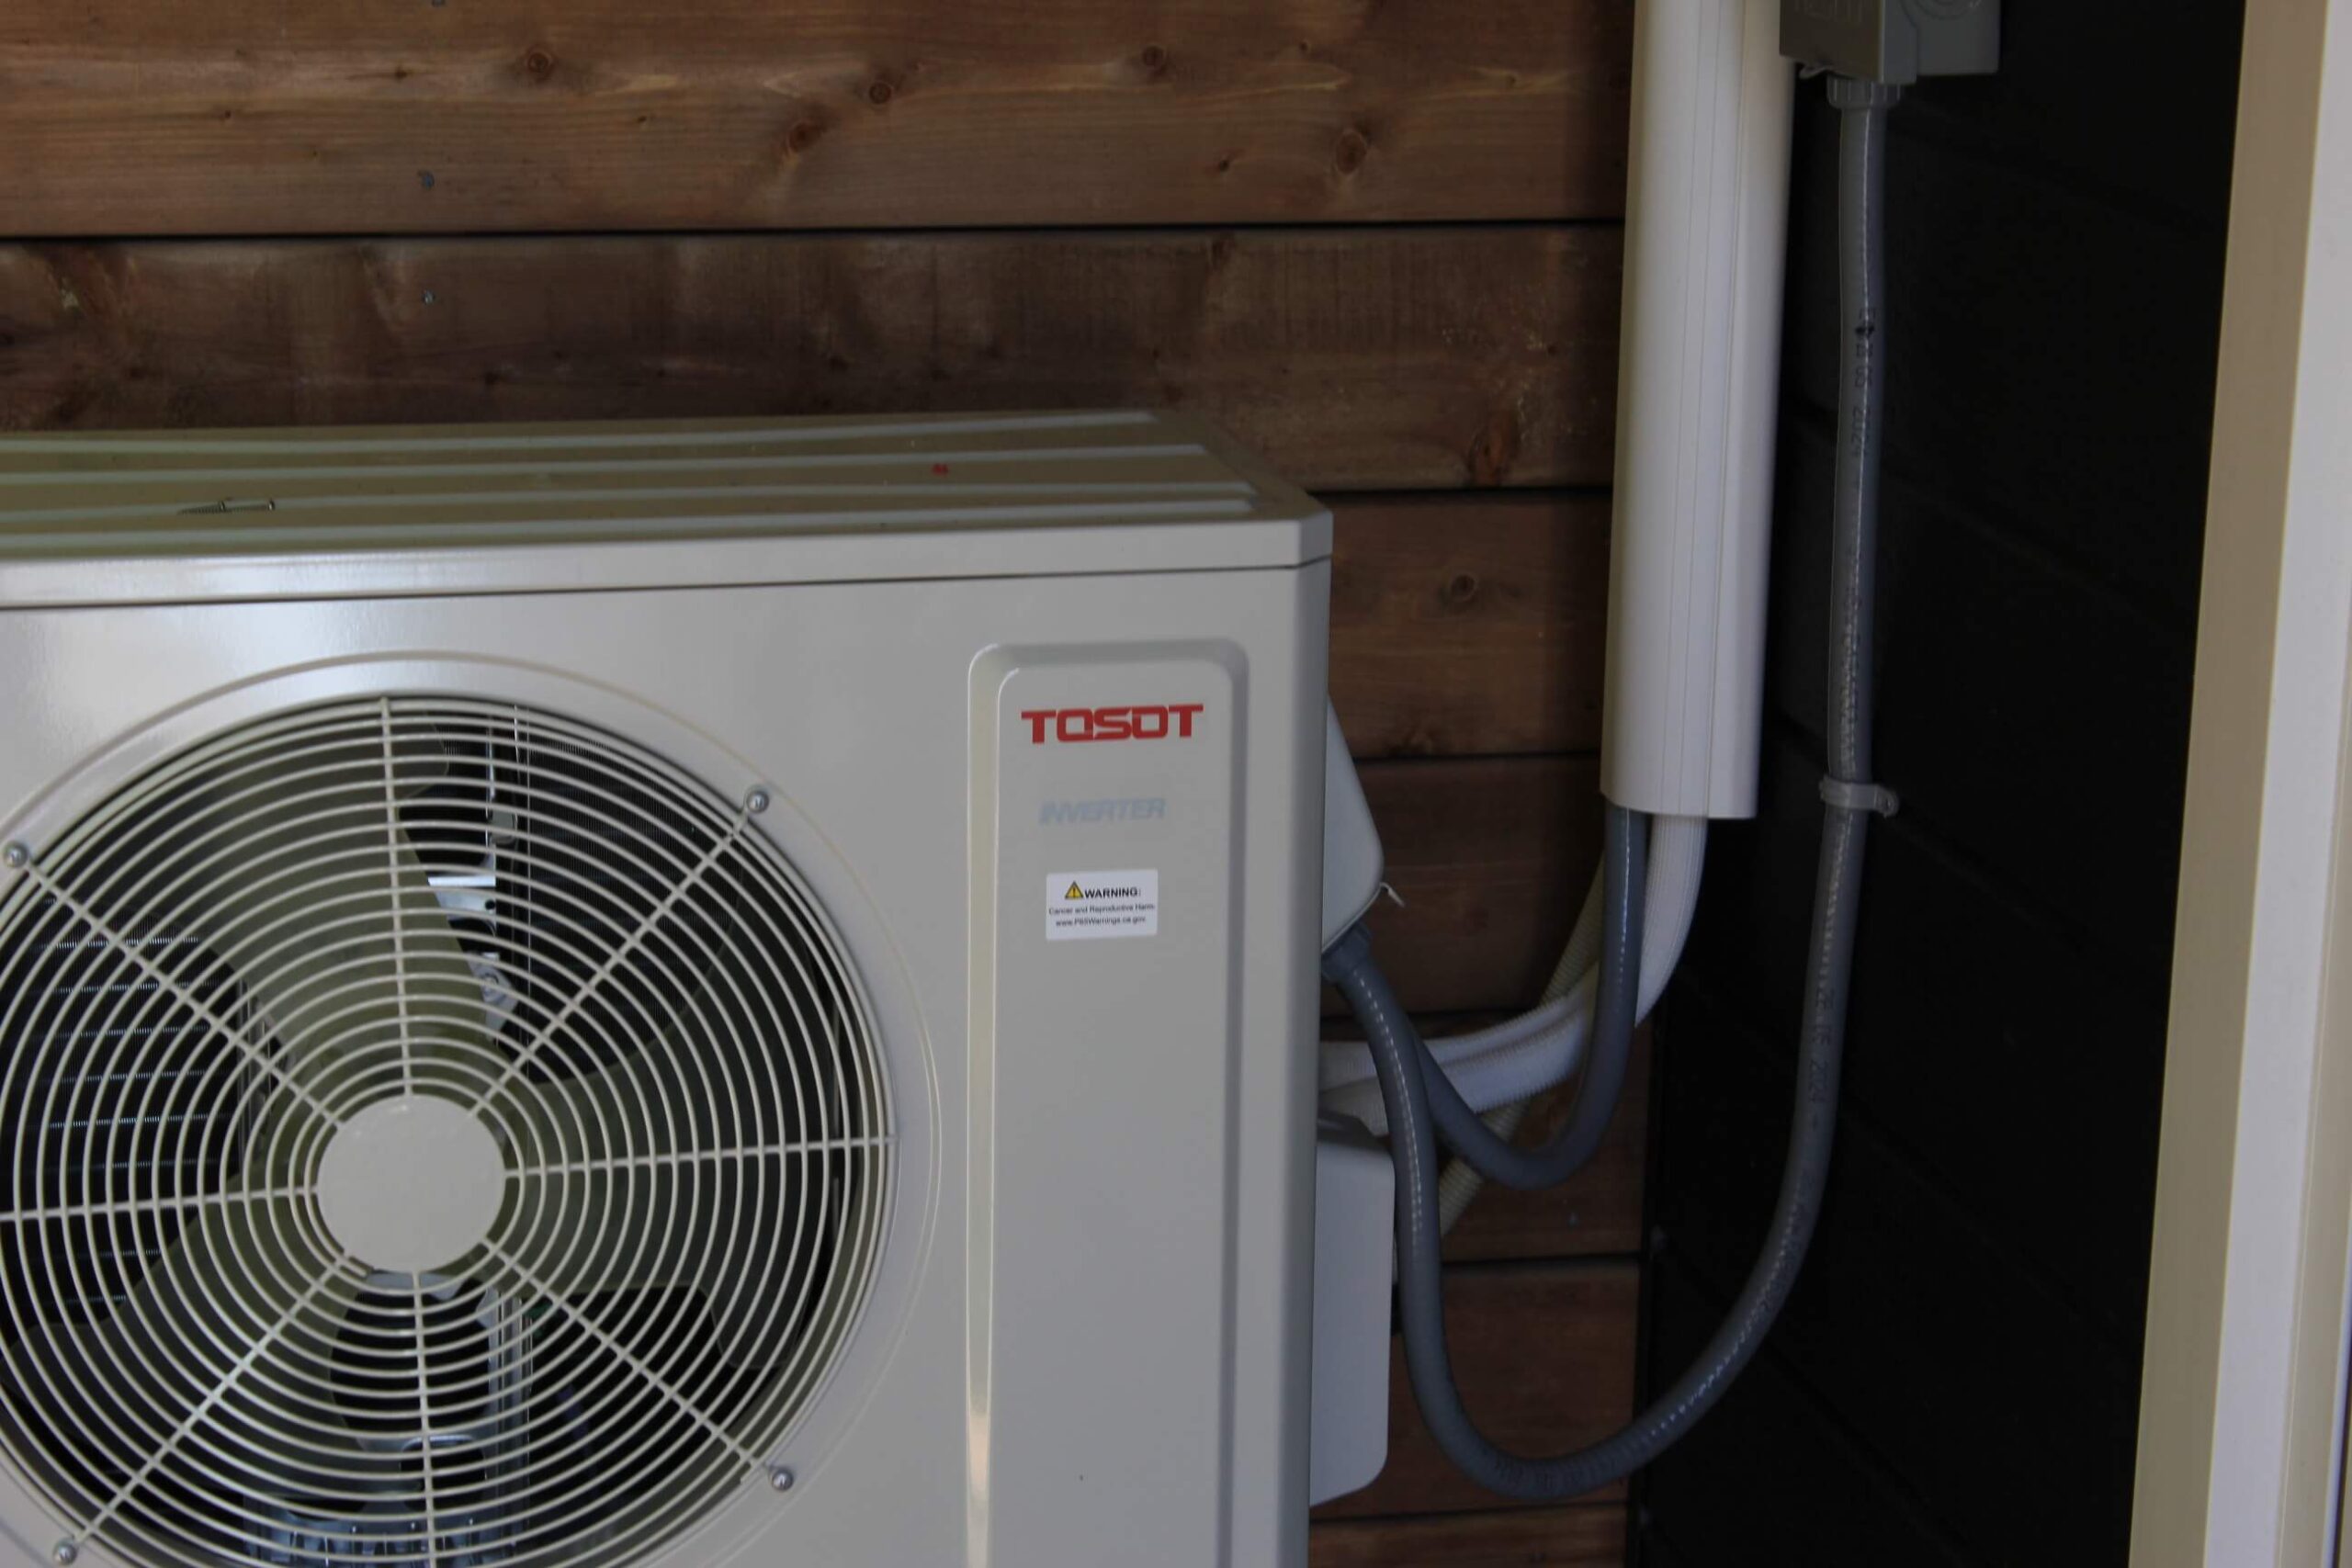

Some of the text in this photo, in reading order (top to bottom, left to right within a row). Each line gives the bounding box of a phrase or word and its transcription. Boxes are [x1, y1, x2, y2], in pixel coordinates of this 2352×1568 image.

[1022, 704, 1204, 743] TOSOT
[1040, 797, 1166, 824] INVERTER
[1048, 907, 1073, 915] Cancer
[1074, 905, 1088, 914] and
[1089, 904, 1134, 915] Reproductive
